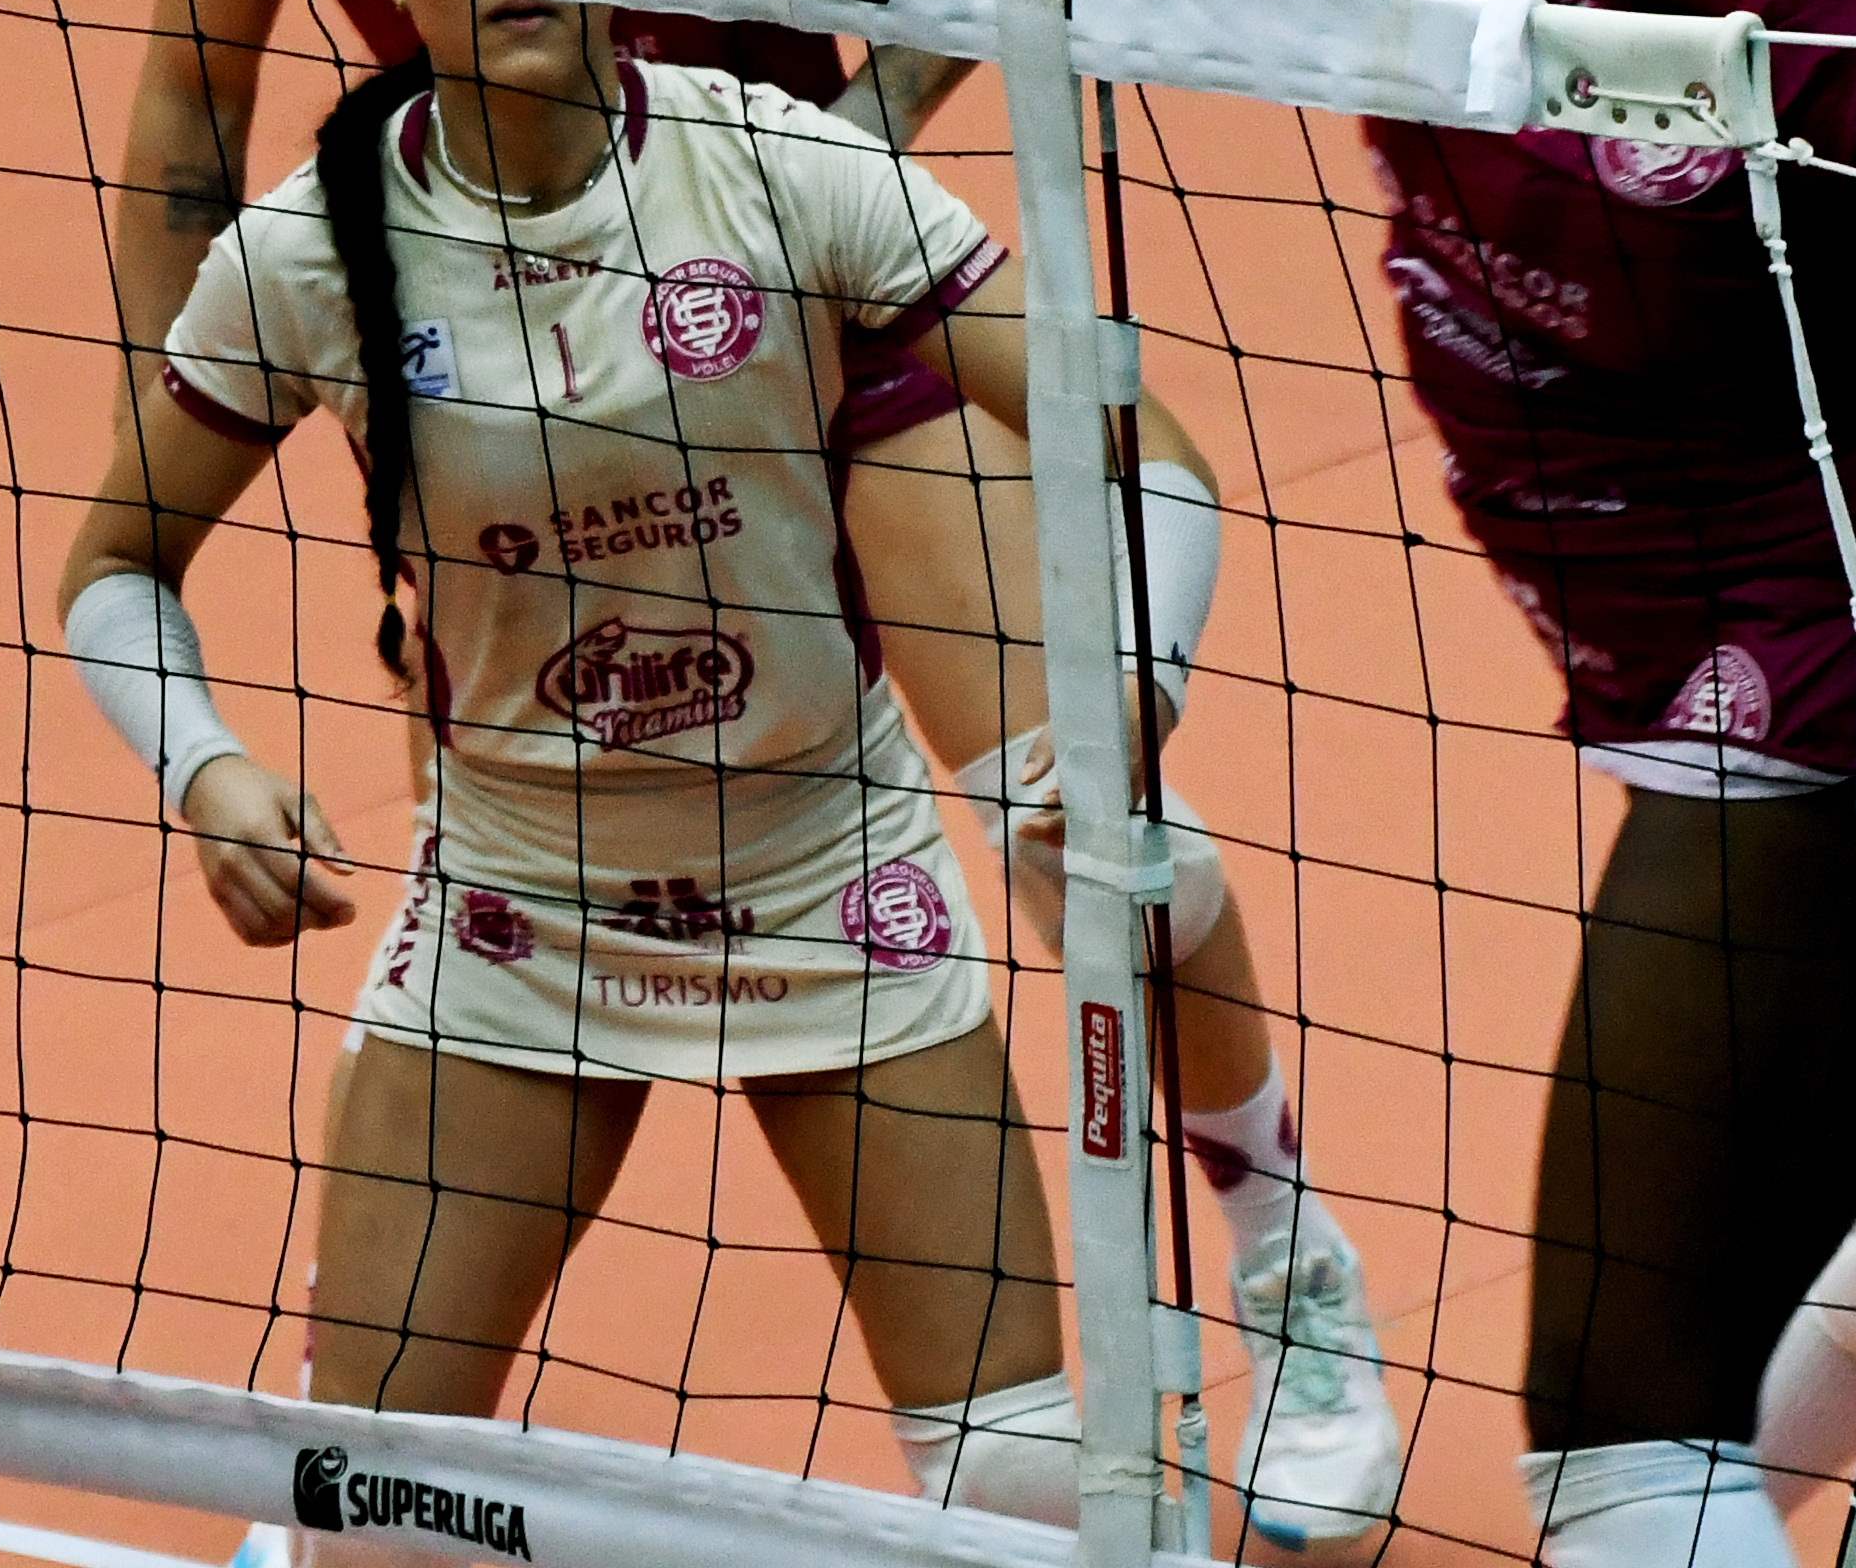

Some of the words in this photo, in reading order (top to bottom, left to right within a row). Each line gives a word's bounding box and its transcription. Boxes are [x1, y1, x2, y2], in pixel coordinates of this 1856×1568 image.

[550, 476, 735, 533] SANCOR
[562, 508, 743, 564] SEGUROS
[558, 646, 731, 703] unilife
[592, 974, 789, 1008] TURISMO
[346, 1468, 532, 1562] SUPERLIGA
